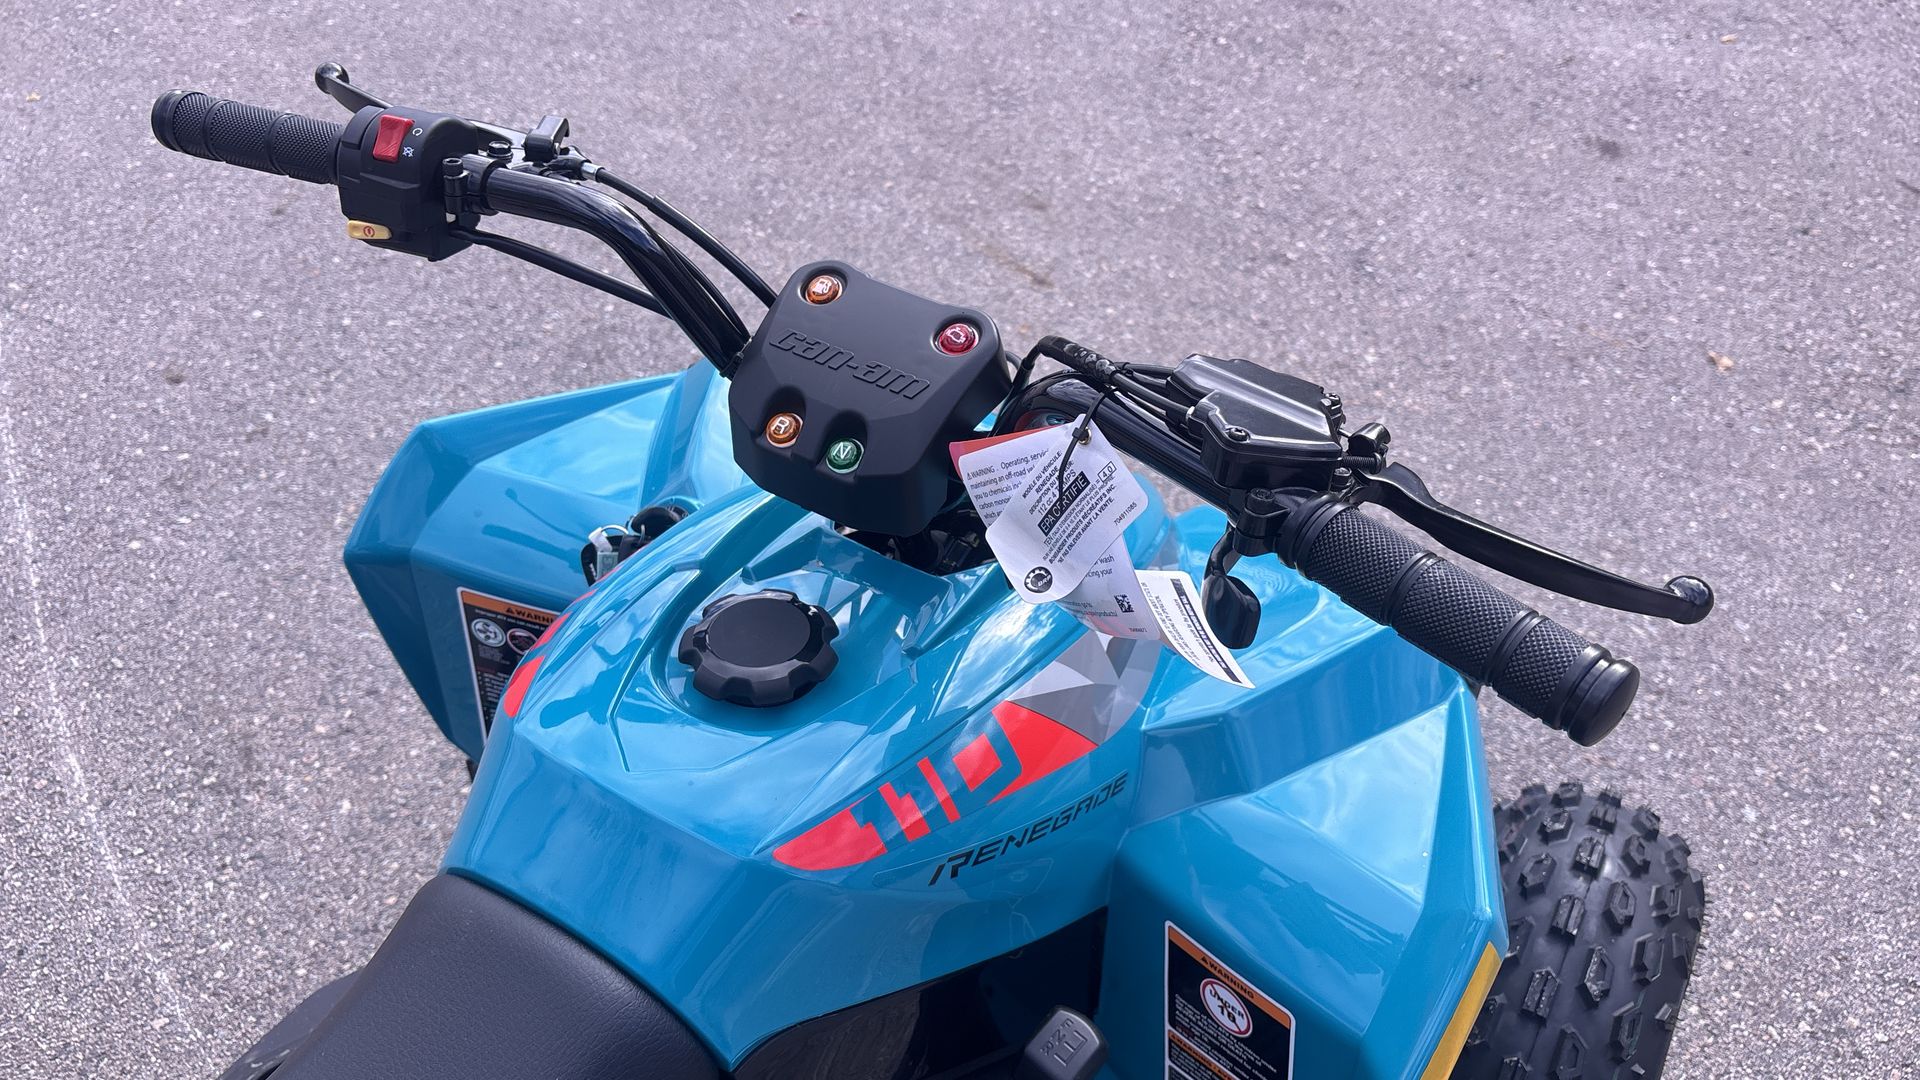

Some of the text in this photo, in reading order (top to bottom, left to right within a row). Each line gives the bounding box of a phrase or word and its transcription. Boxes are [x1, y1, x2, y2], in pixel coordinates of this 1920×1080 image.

[769, 328, 931, 400] can-am
[771, 416, 790, 435] R
[833, 442, 852, 460] N
[972, 466, 995, 478] WARNING
[1000, 456, 1031, 470] Operating,
[1034, 472, 1043, 482] DU
[970, 477, 998, 490] maintaining
[1005, 467, 1027, 481] off-road
[1034, 465, 1059, 494] RENEGADE
[1048, 479, 1056, 488] DU
[974, 494, 983, 502] you
[989, 484, 1012, 497] chemicals
[1040, 473, 1087, 533] EPA CERTIFIÉ
[979, 499, 995, 510] carbon
[1037, 502, 1048, 515] 112
[1045, 496, 1053, 507] cc
[1113, 500, 1137, 526] 704911085
[1048, 538, 1067, 564] BOMBARDIER
[1065, 518, 1083, 540] PRODUITS
[1080, 491, 1107, 521] RÉCRÉATIFS
[1061, 548, 1069, 558] PAS
[1066, 531, 1082, 551] ENLEVER
[1080, 517, 1093, 533] AVANT
[1091, 511, 1099, 520] LA
[1044, 534, 1053, 547] TEN
[1098, 554, 1115, 565] wash
[1100, 568, 1113, 578] your
[928, 773, 1128, 887] RENEGADE
[1209, 961, 1254, 999] WARNING
[1209, 988, 1244, 1020] UNDER
